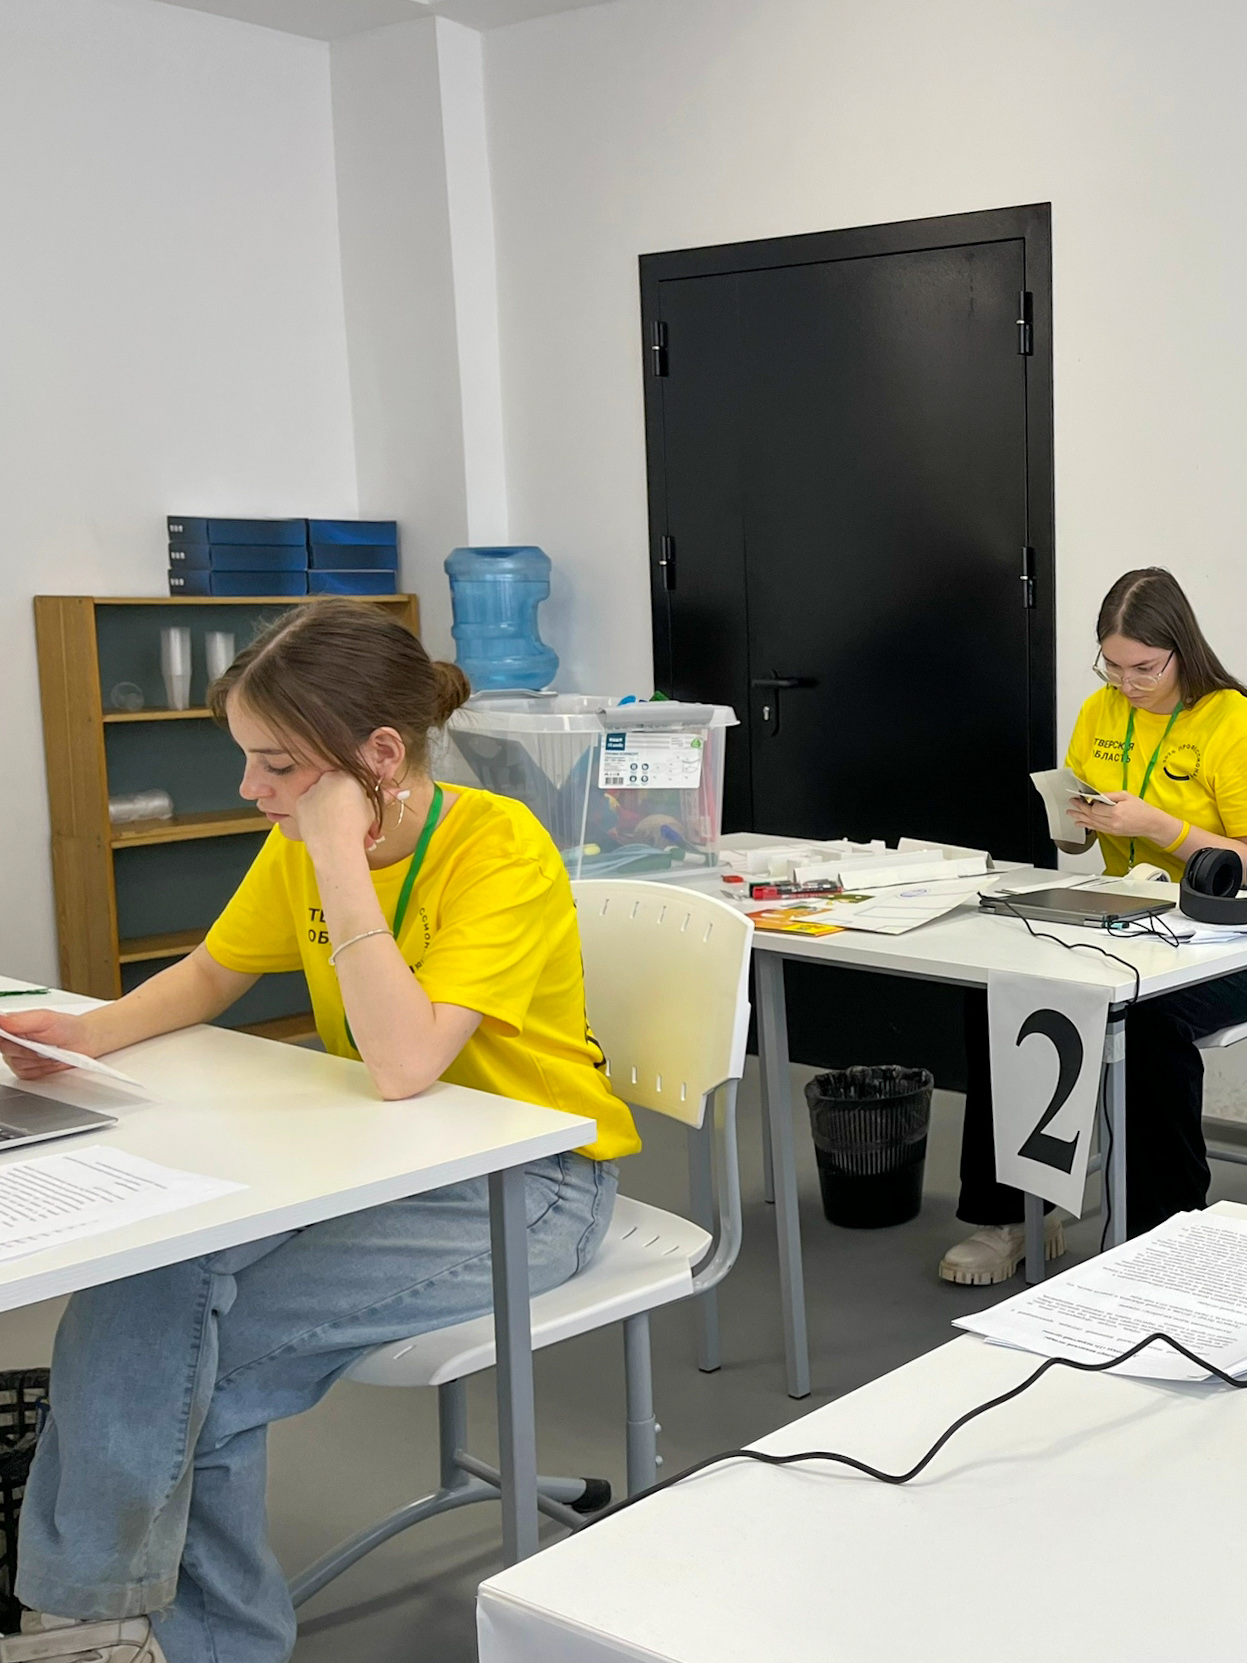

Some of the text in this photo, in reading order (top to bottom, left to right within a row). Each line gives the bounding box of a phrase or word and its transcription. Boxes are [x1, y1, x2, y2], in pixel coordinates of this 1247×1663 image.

[1094, 738, 1135, 751] ТВЕРСКЯ
[1093, 750, 1131, 763] БЛАСТЬ
[1015, 1008, 1084, 1175] 2
